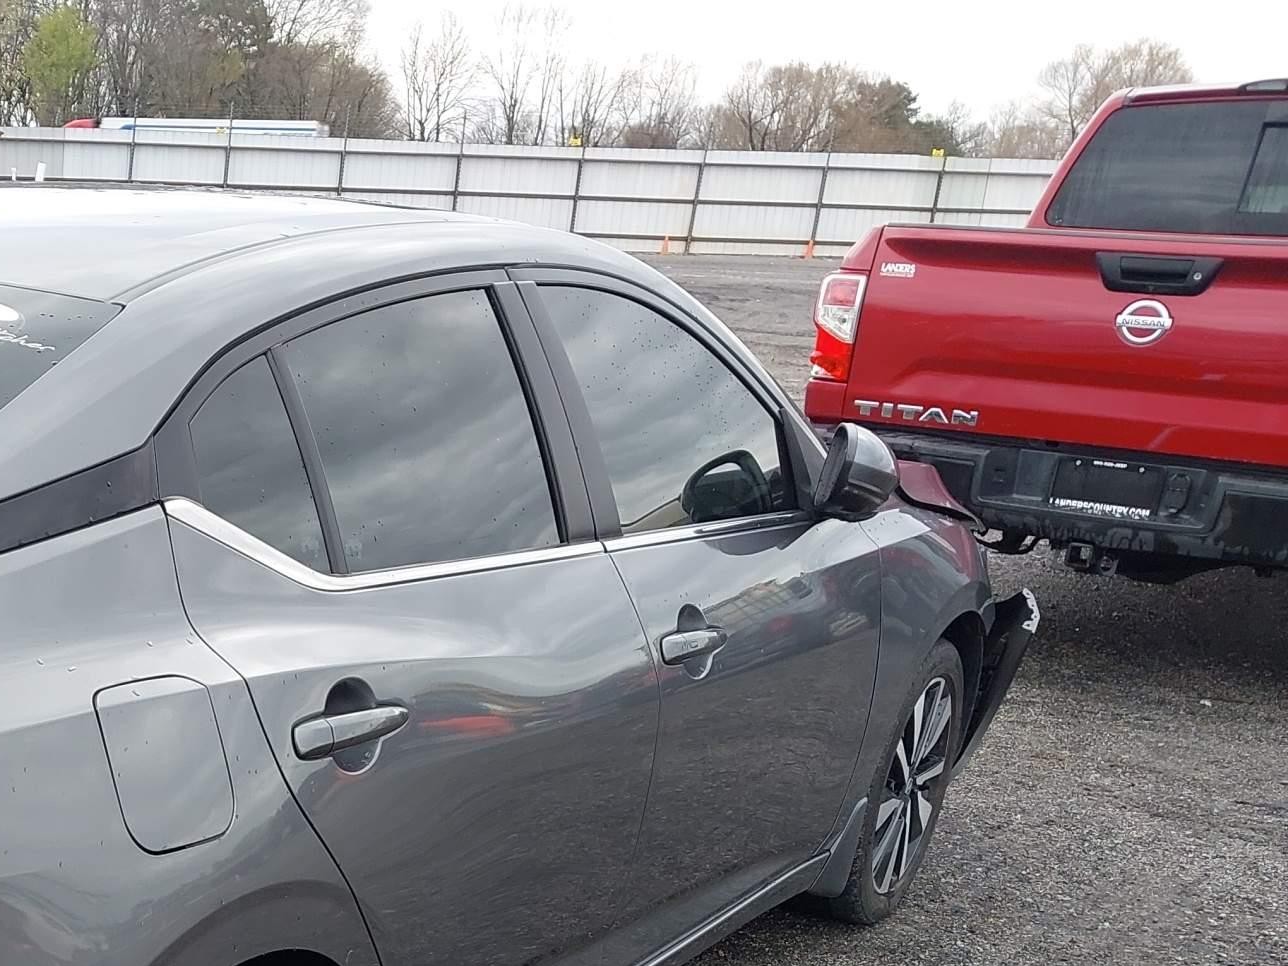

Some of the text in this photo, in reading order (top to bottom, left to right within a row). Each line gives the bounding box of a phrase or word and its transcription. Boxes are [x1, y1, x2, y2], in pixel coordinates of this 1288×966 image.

[880, 262, 916, 274] LANDERS
[1121, 318, 1165, 328] NISSAN
[854, 399, 979, 426] TITAN
